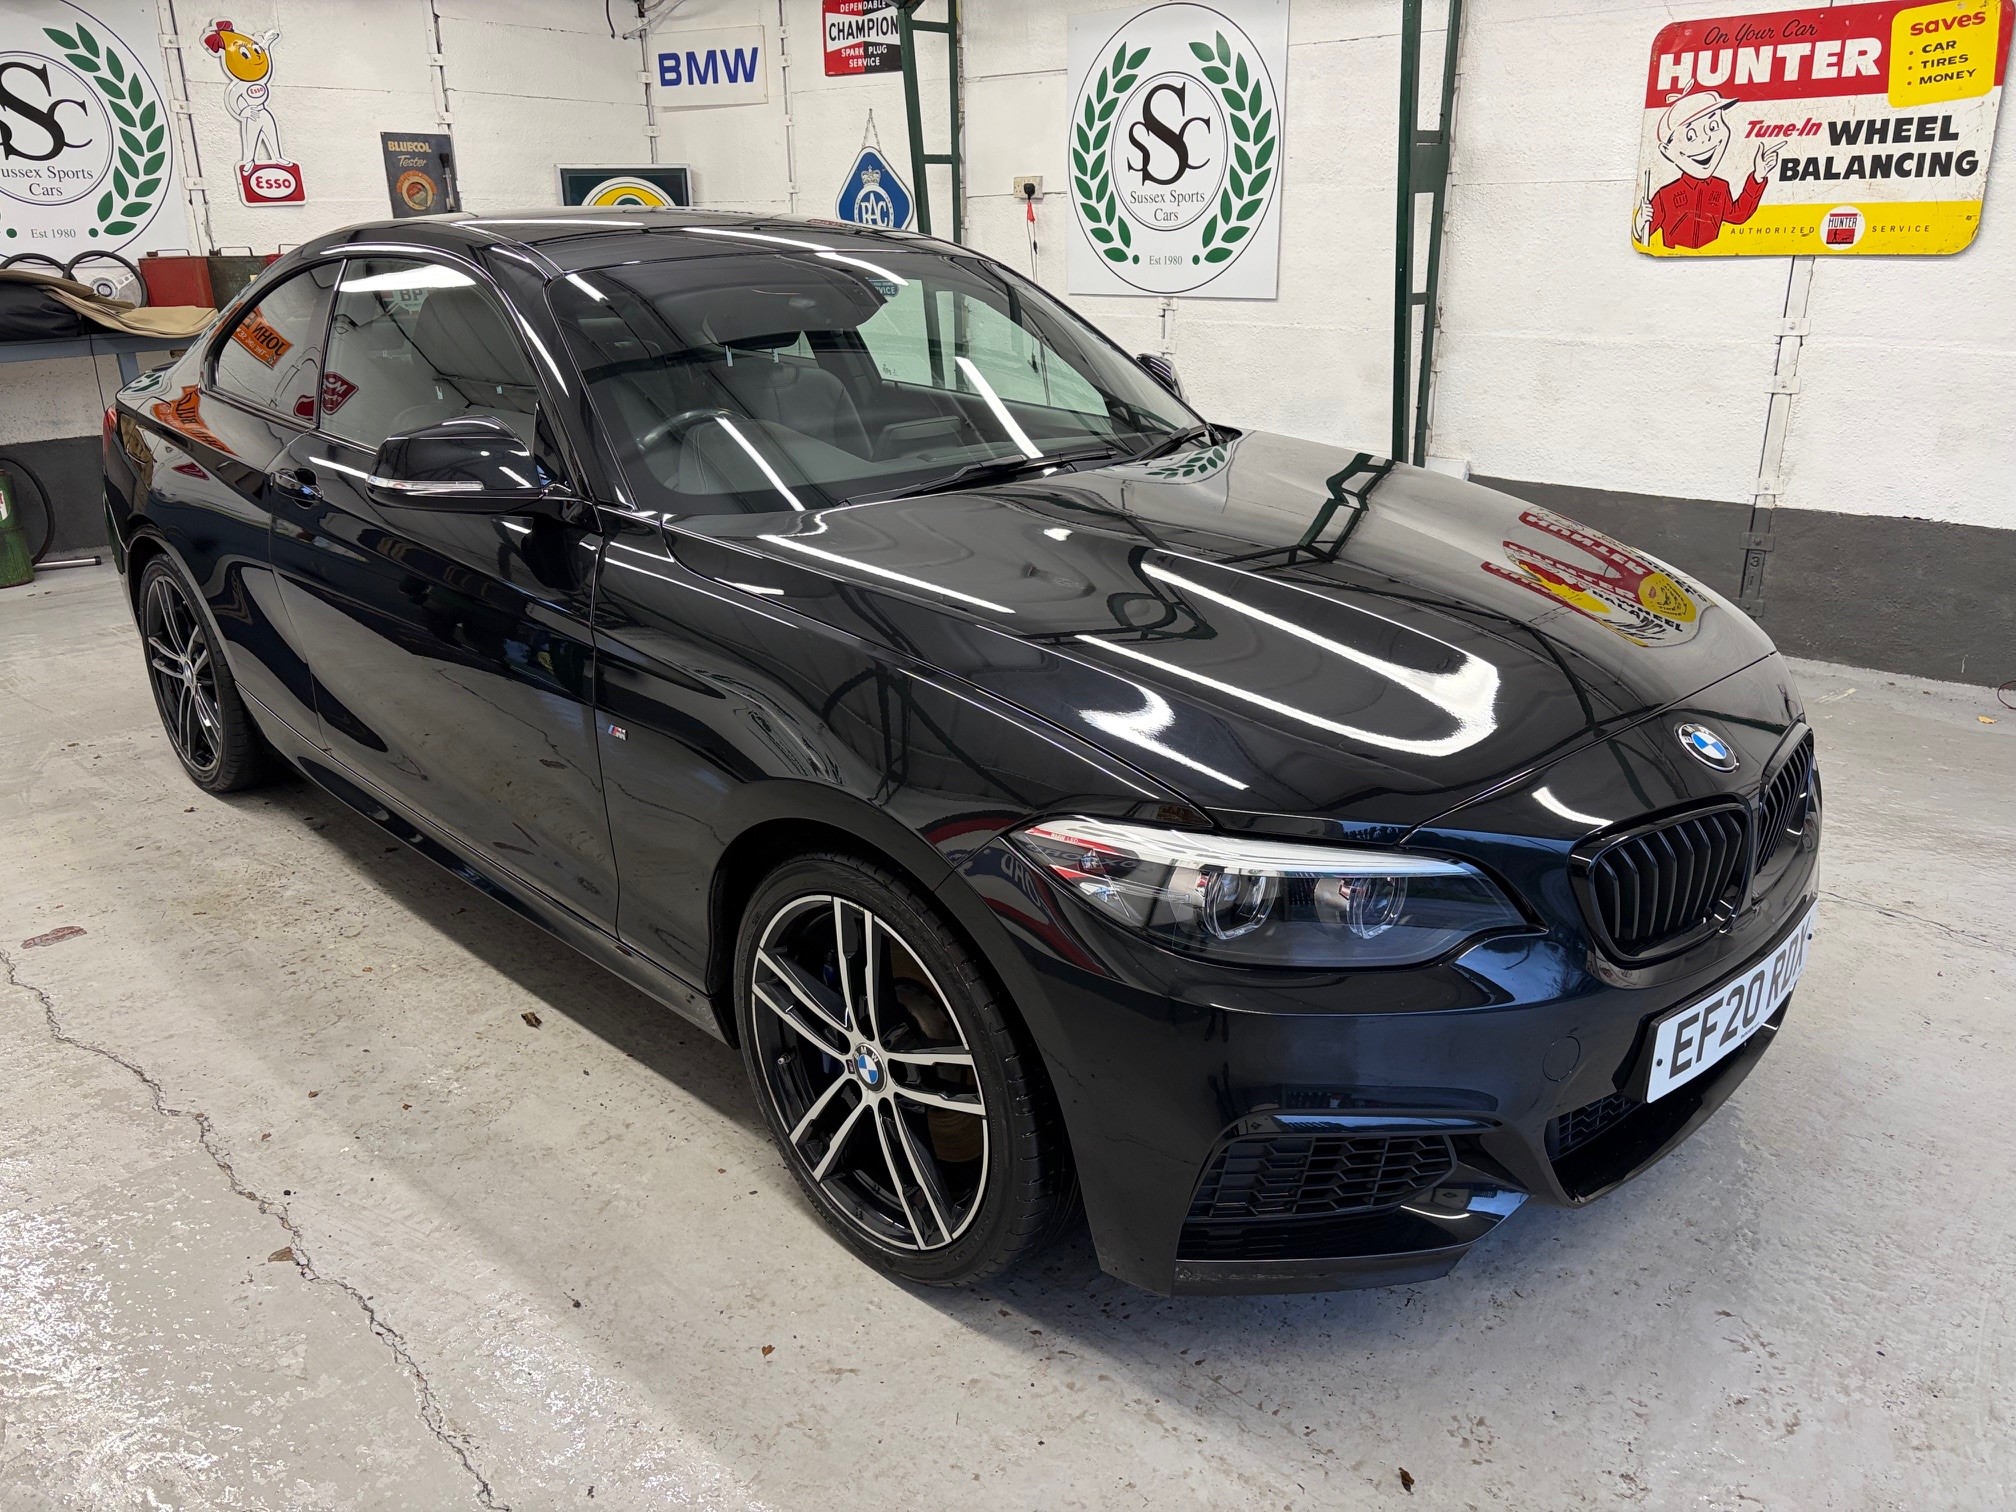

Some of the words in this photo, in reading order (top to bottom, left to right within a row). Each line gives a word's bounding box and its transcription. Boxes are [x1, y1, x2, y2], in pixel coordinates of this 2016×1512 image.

[840, 0, 886, 13] DEPENDABLE
[829, 15, 899, 41] CHAMPION
[1910, 11, 1986, 36] saves
[1704, 26, 1730, 46] On
[1735, 23, 1775, 47] Your
[1782, 19, 1818, 38] Car
[841, 47, 864, 58] SPARK
[868, 45, 888, 55] PLUG
[1922, 40, 1957, 54] CAR
[658, 47, 759, 87] BMW
[849, 57, 880, 68] SERVICE
[1656, 37, 1882, 91] HUNTER
[1921, 54, 1969, 69] TIRES
[1919, 68, 1977, 85] MONEY
[1744, 117, 1823, 139] Tune-In
[1828, 115, 1960, 146] WHEEL
[387, 141, 432, 153] BLUECOL
[398, 154, 428, 167] Tester
[1779, 150, 1980, 183] BALANCING
[1, 167, 42, 180] ussex
[47, 166, 94, 182] Sports
[29, 183, 63, 197] Cars
[255, 176, 292, 190] Esso
[1130, 190, 1166, 204] Sussex
[1169, 189, 1205, 205] Sports
[1154, 208, 1179, 222] Cars
[1828, 217, 1858, 228] HUNTER
[31, 229, 48, 239] Est
[51, 228, 76, 239] 1980
[1731, 226, 1815, 235] AUTHORIZED
[1149, 255, 1162, 266] Est
[1163, 255, 1183, 266] 1980
[1669, 969, 1766, 1080] EF20
[1765, 916, 1811, 1011] RDX
